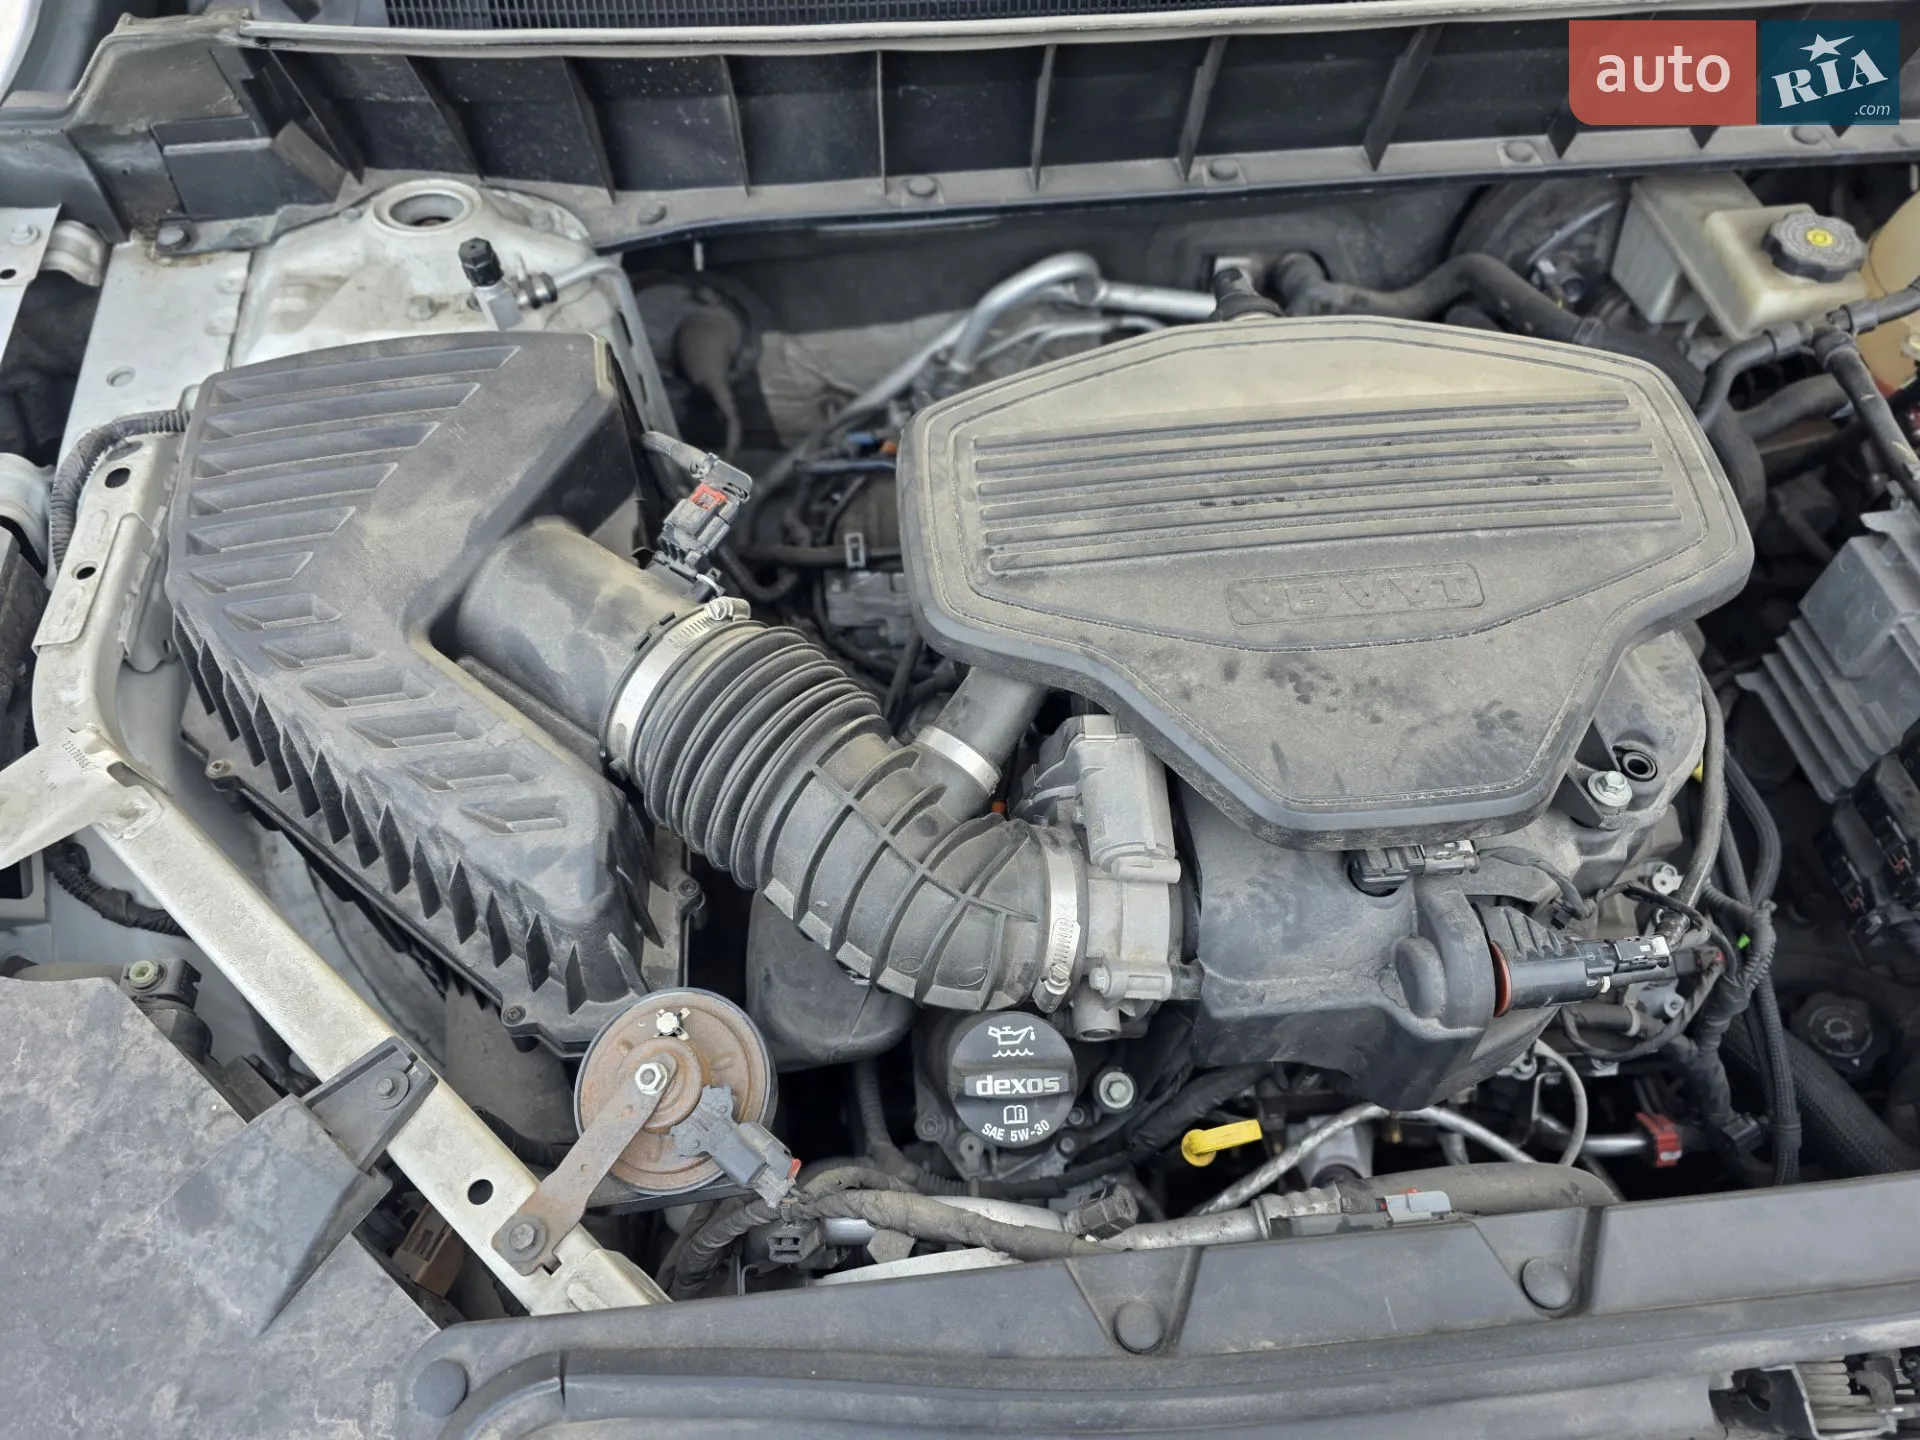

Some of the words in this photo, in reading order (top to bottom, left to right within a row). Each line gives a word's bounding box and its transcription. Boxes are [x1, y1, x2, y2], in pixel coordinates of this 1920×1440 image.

[975, 1074, 1062, 1096] dexos
[981, 1122, 1005, 1141] SAE
[1010, 1119, 1050, 1142] 5W-30
